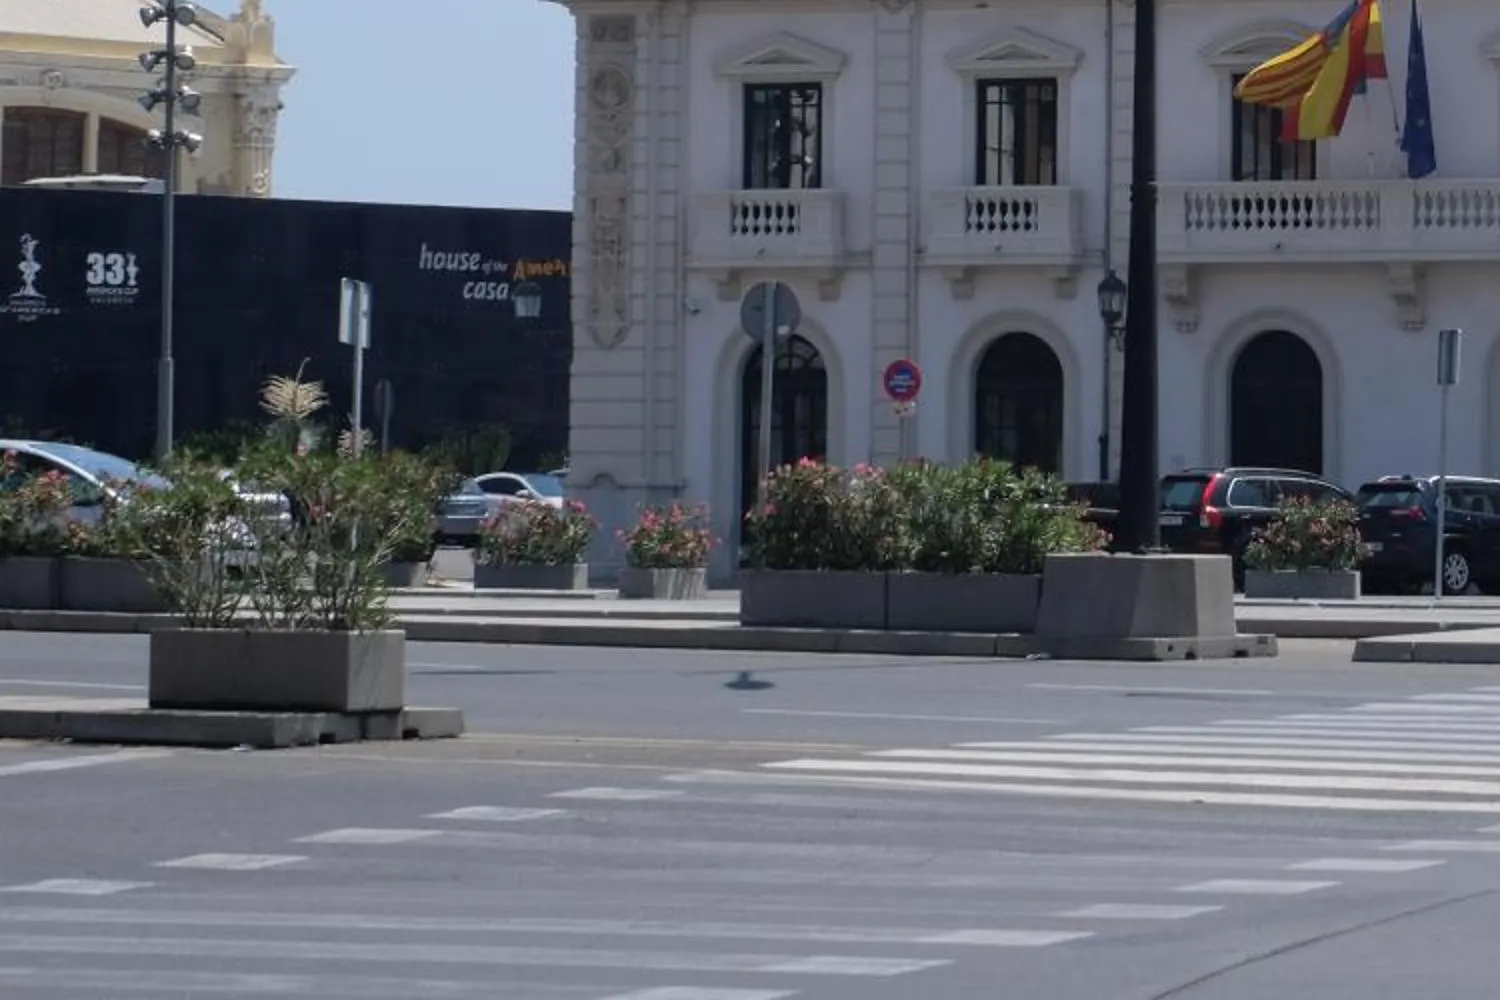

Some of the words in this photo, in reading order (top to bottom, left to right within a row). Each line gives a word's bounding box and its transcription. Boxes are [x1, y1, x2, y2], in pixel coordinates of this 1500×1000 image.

[86, 252, 125, 285] 33
[419, 242, 481, 271] house
[463, 281, 510, 301] casa
